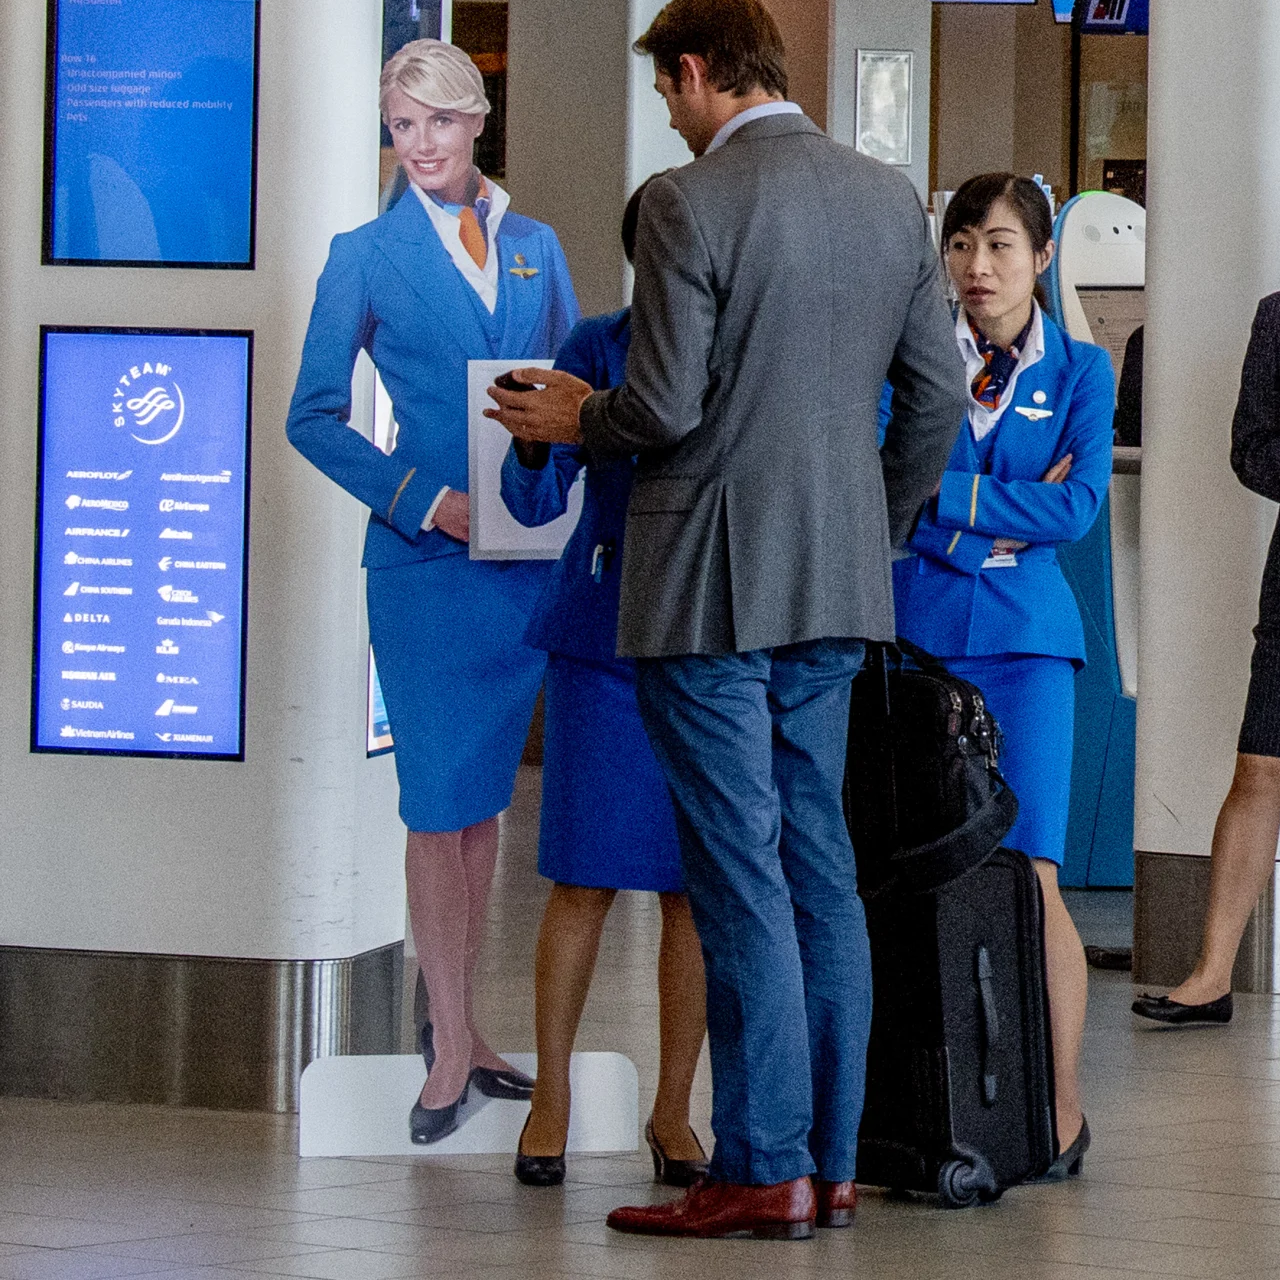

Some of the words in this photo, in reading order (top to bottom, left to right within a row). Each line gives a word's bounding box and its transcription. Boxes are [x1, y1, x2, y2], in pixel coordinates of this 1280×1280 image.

[149, 70, 182, 79] minors
[111, 85, 150, 95] luggage
[67, 99, 122, 109] Passengers
[125, 99, 146, 108] with
[150, 99, 189, 108] reduced
[192, 100, 233, 111] mobility
[67, 113, 87, 122] Pets
[112, 362, 169, 428] SKYTEAM
[66, 470, 118, 480] AEROFLOT
[65, 527, 121, 537] AIRFRANCE
[74, 614, 110, 623] DELTA
[165, 676, 199, 684] MEA
[71, 701, 104, 709] SAUDIA
